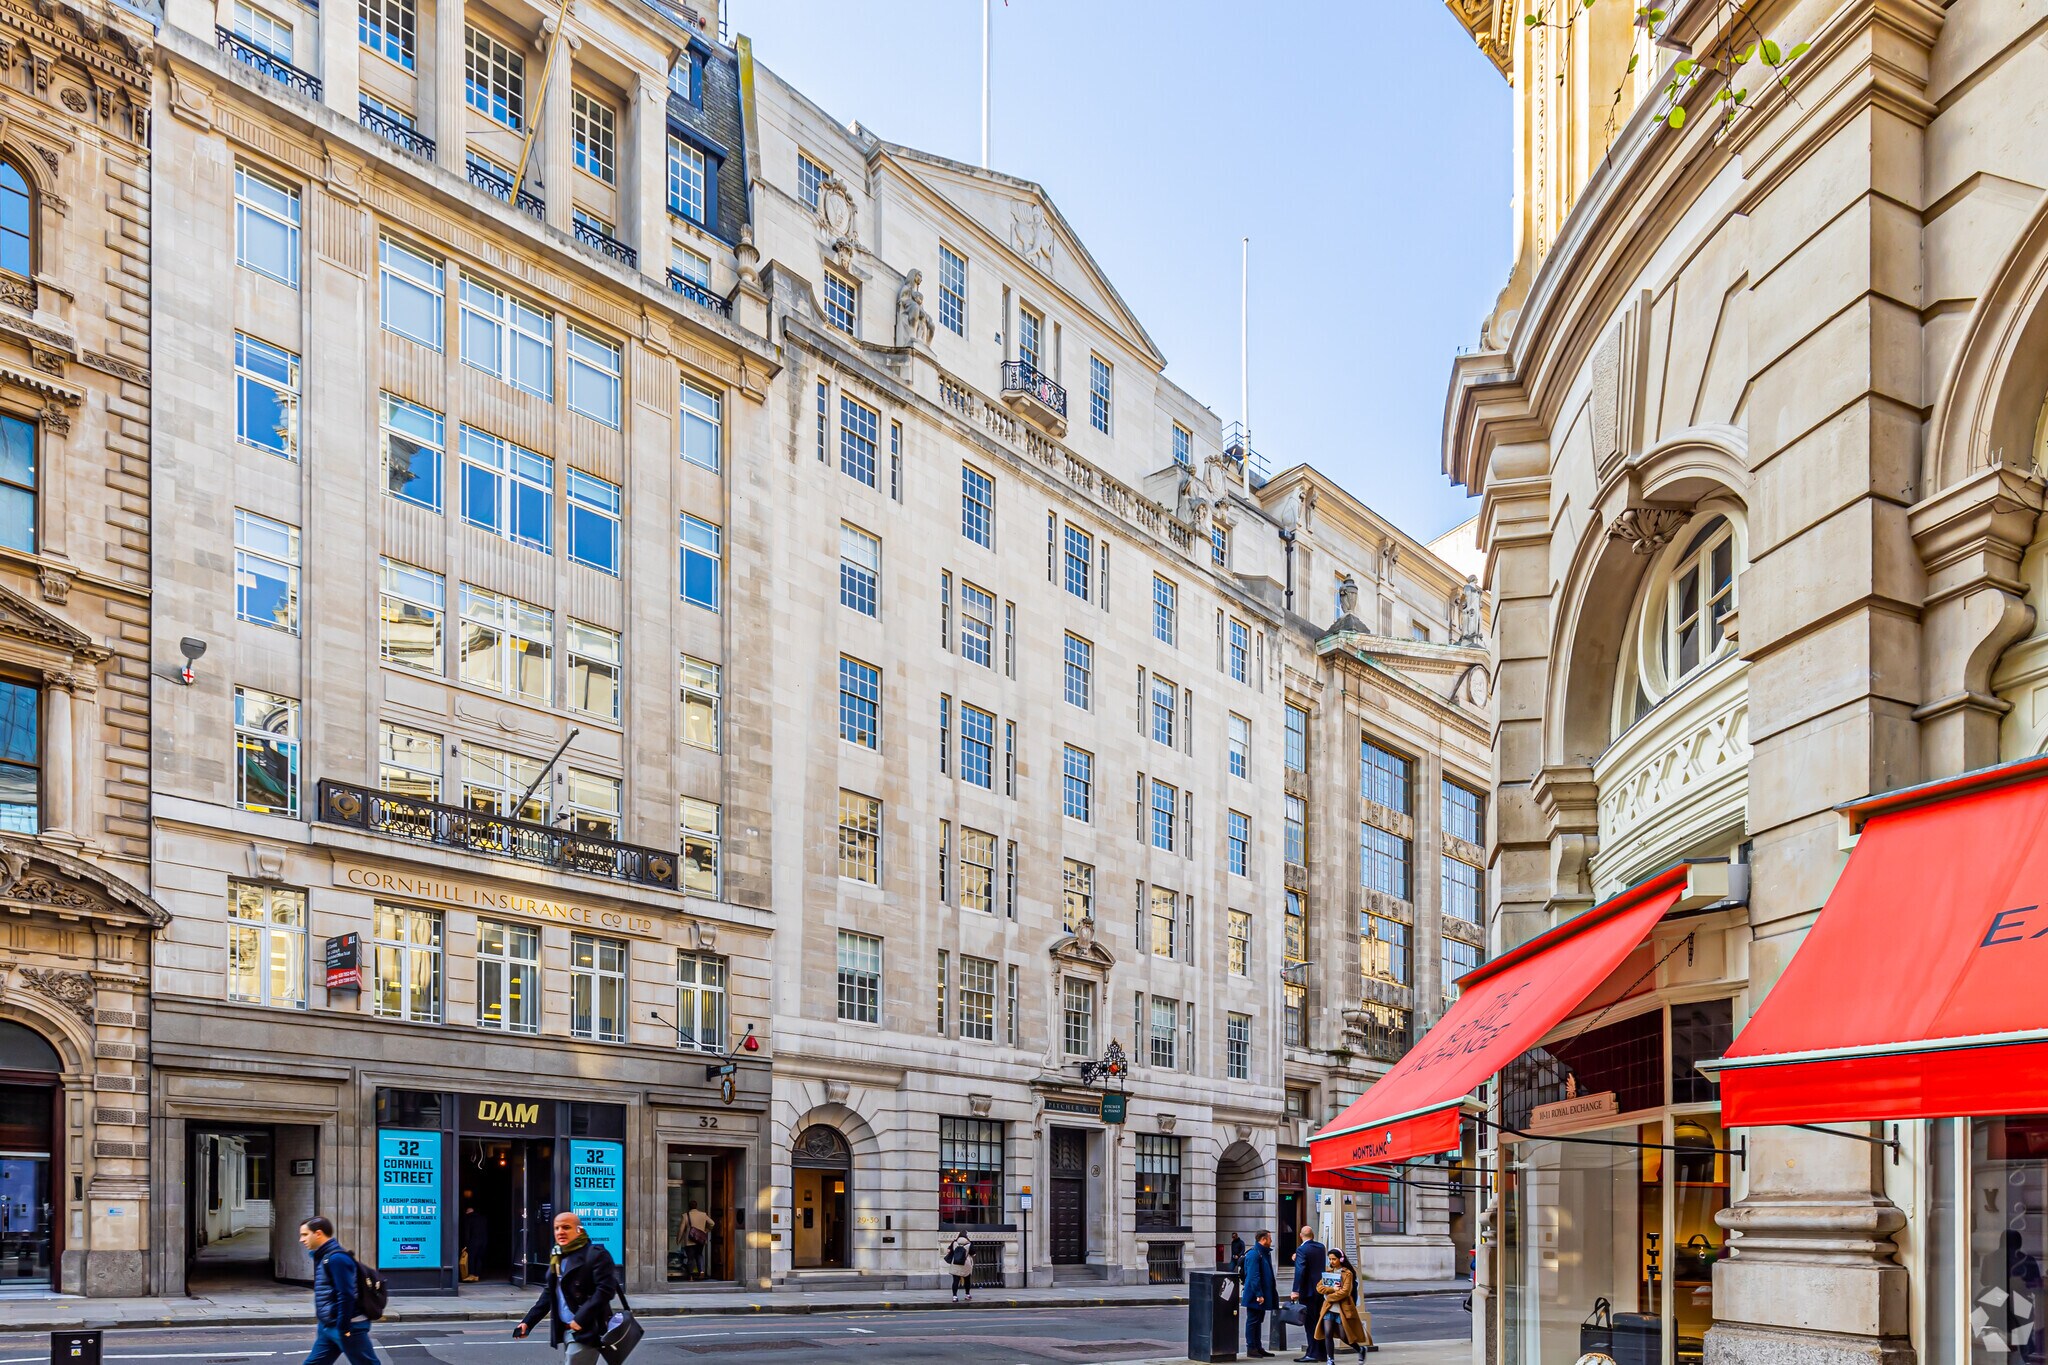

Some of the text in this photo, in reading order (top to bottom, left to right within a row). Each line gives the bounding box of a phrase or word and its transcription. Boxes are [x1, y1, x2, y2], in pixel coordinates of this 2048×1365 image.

[348, 869, 464, 902] CORNHILL
[474, 890, 592, 923] INSURANCE
[628, 917, 652, 932] LTD
[1400, 1023, 1512, 1077] EXCHANGE
[478, 1100, 539, 1124] DAM
[1551, 1107, 1569, 1118] ROYAL
[1569, 1100, 1603, 1114] EXCHANGE
[699, 1116, 718, 1128] 32
[399, 1140, 419, 1156] 32
[1352, 1141, 1387, 1160] MONTBLANC
[586, 1150, 604, 1163] 32
[384, 1159, 433, 1170] CORNHILL
[574, 1166, 616, 1176] CORNHILL
[384, 1170, 433, 1184] STREET
[574, 1177, 616, 1189] STREET
[381, 1205, 437, 1215] UNIT TO LET
[573, 1208, 619, 1216] UNIT TO LET
